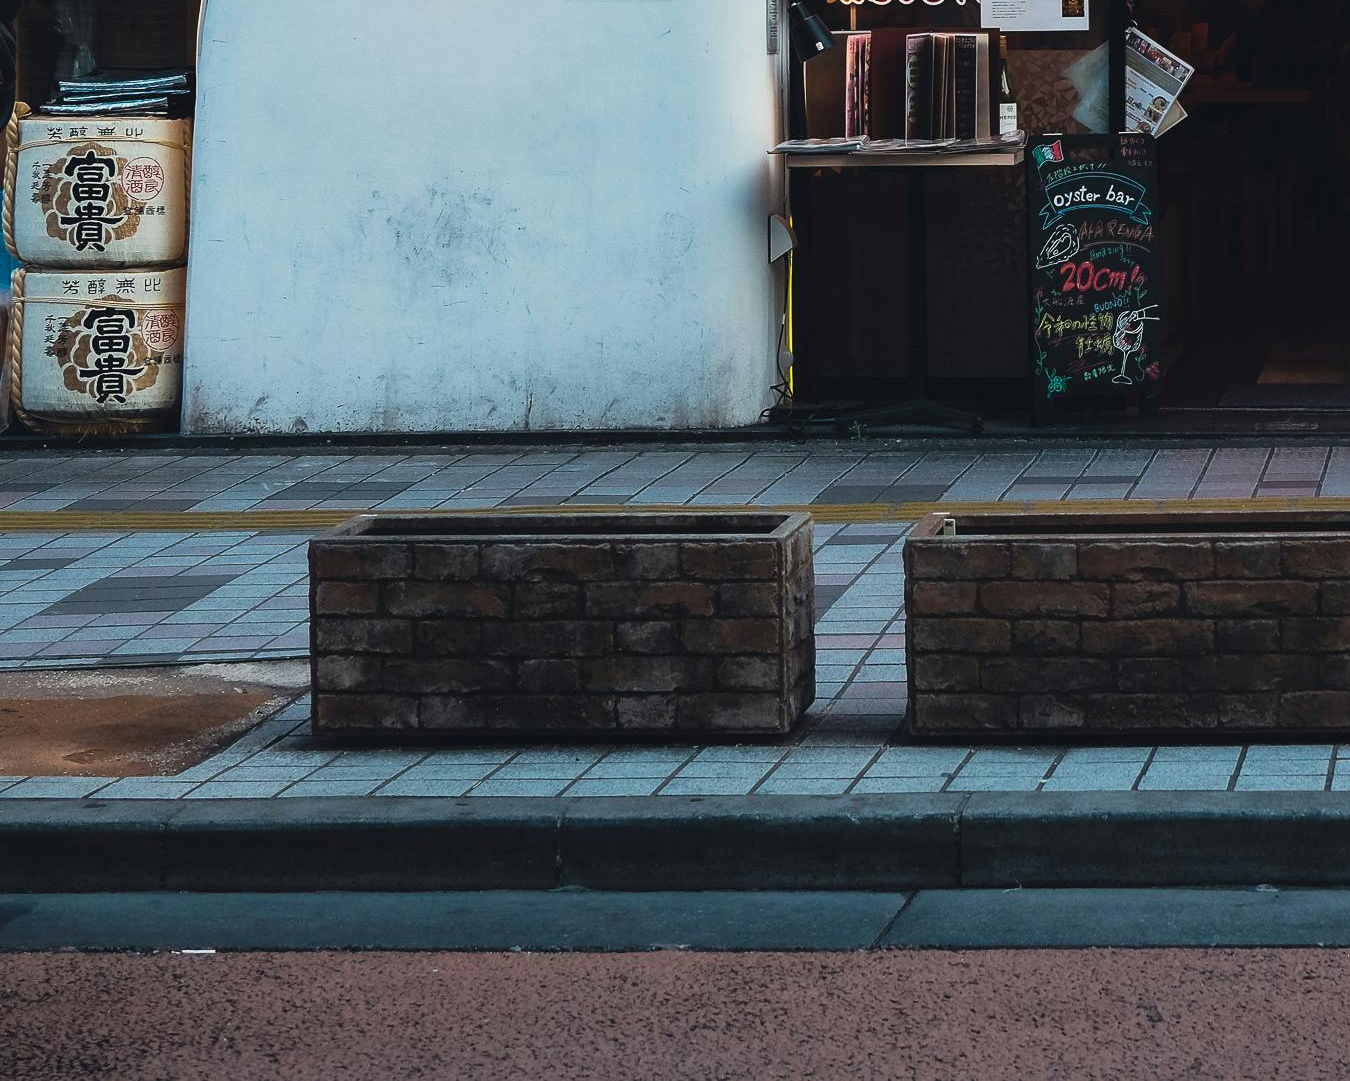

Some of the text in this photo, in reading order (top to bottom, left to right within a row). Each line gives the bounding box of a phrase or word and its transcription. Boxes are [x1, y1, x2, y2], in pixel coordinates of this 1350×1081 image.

[61, 150, 125, 253] 富貴
[1053, 184, 1135, 207] oyster bar
[1107, 219, 1153, 242] RENGA
[62, 277, 161, 295] 芳醇無比
[1060, 261, 1140, 293] 20cm!
[79, 307, 144, 405] 富貴
